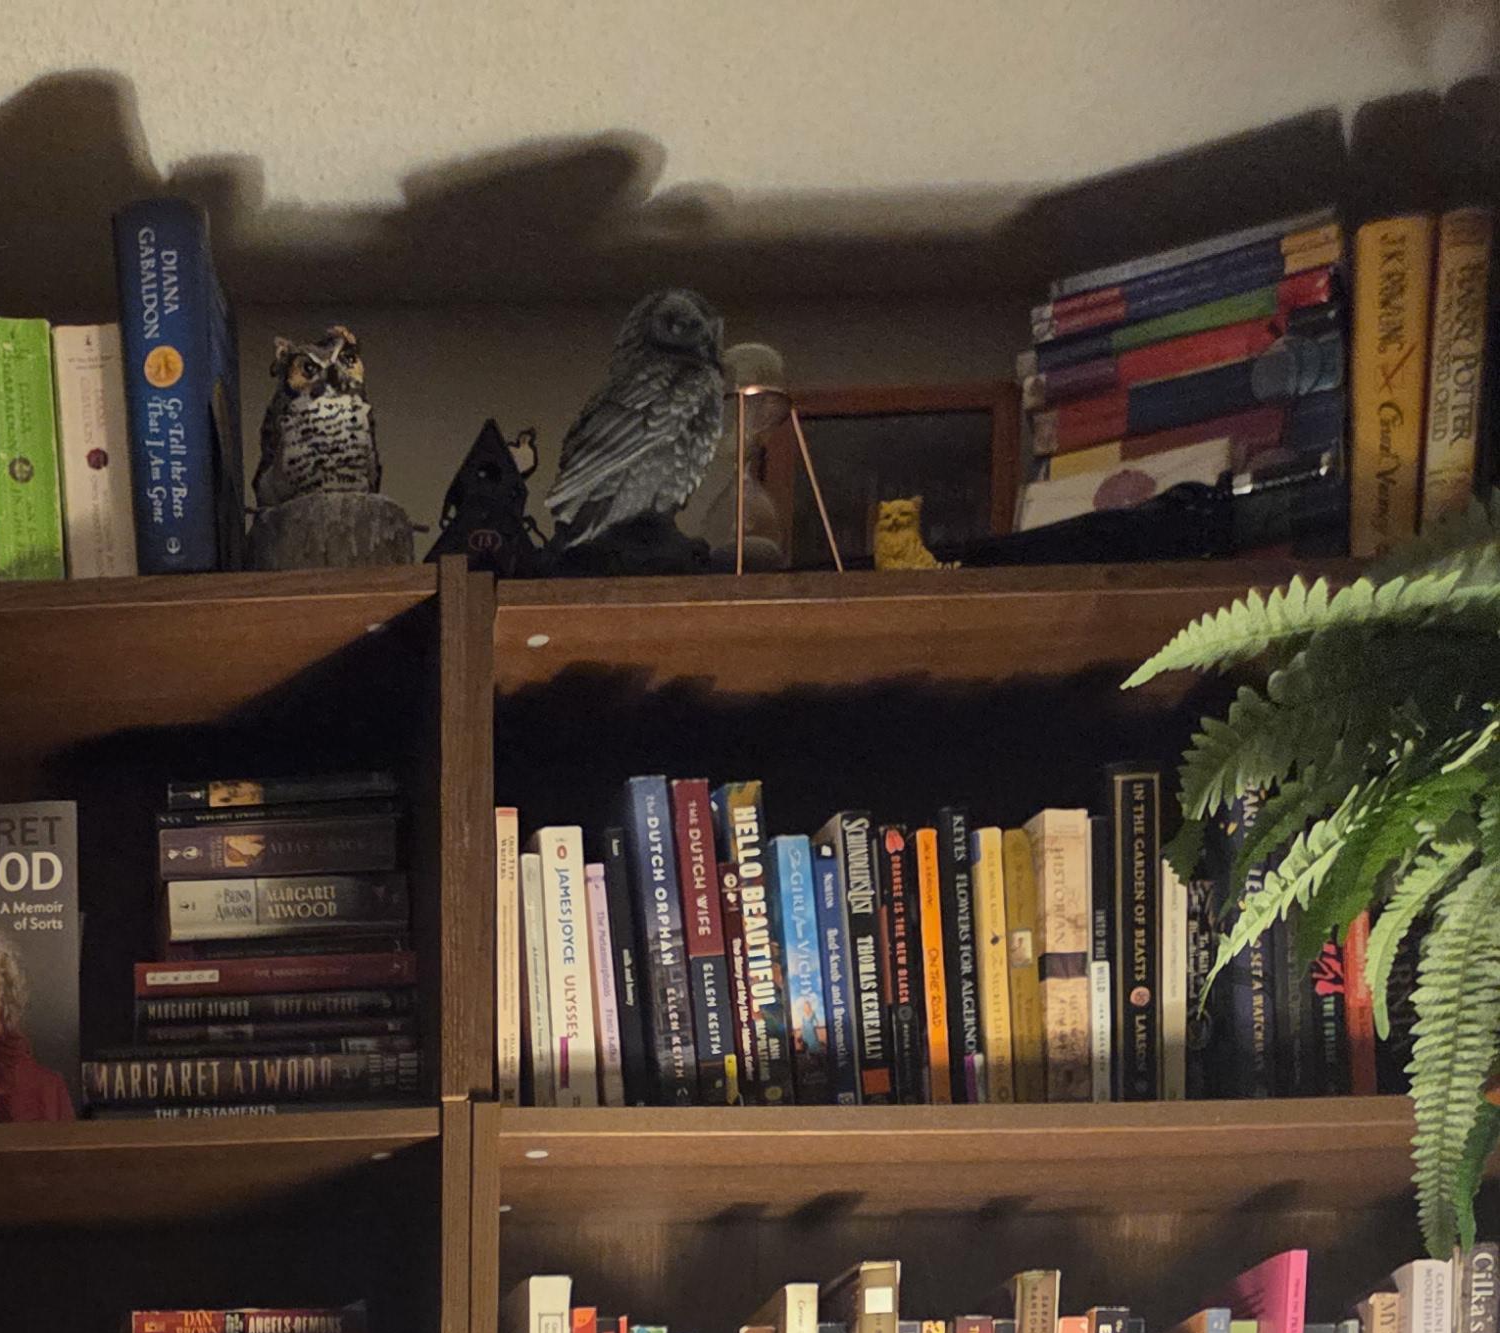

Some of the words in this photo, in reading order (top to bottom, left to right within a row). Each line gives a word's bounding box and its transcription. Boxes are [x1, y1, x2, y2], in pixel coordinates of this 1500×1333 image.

[138, 227, 160, 339] GABALDON
[161, 250, 180, 315] DIANA
[1134, 782, 1143, 795] IN
[1134, 798, 1144, 825] THE
[687, 799, 697, 826] THE
[689, 828, 705, 887] DUTCH
[735, 806, 763, 877] HELLO
[1133, 831, 1144, 903] GARDEN
[0, 905, 7, 914] A
[12, 901, 63, 915] Memoir
[556, 868, 572, 915] JAMES
[695, 891, 711, 938] WIFE
[14, 919, 27, 932] of
[31, 917, 63, 932] Sorts
[1134, 906, 1145, 926] OF
[558, 919, 575, 965] JOYCE
[743, 881, 777, 1007] BEAUTIFUL
[1134, 929, 1146, 987] BEASTS
[564, 975, 578, 1039] ULYSSES
[94, 1061, 221, 1099] MARGARET
[232, 1058, 332, 1093] ATWOOD
[1471, 1252, 1492, 1333] Cilka's
